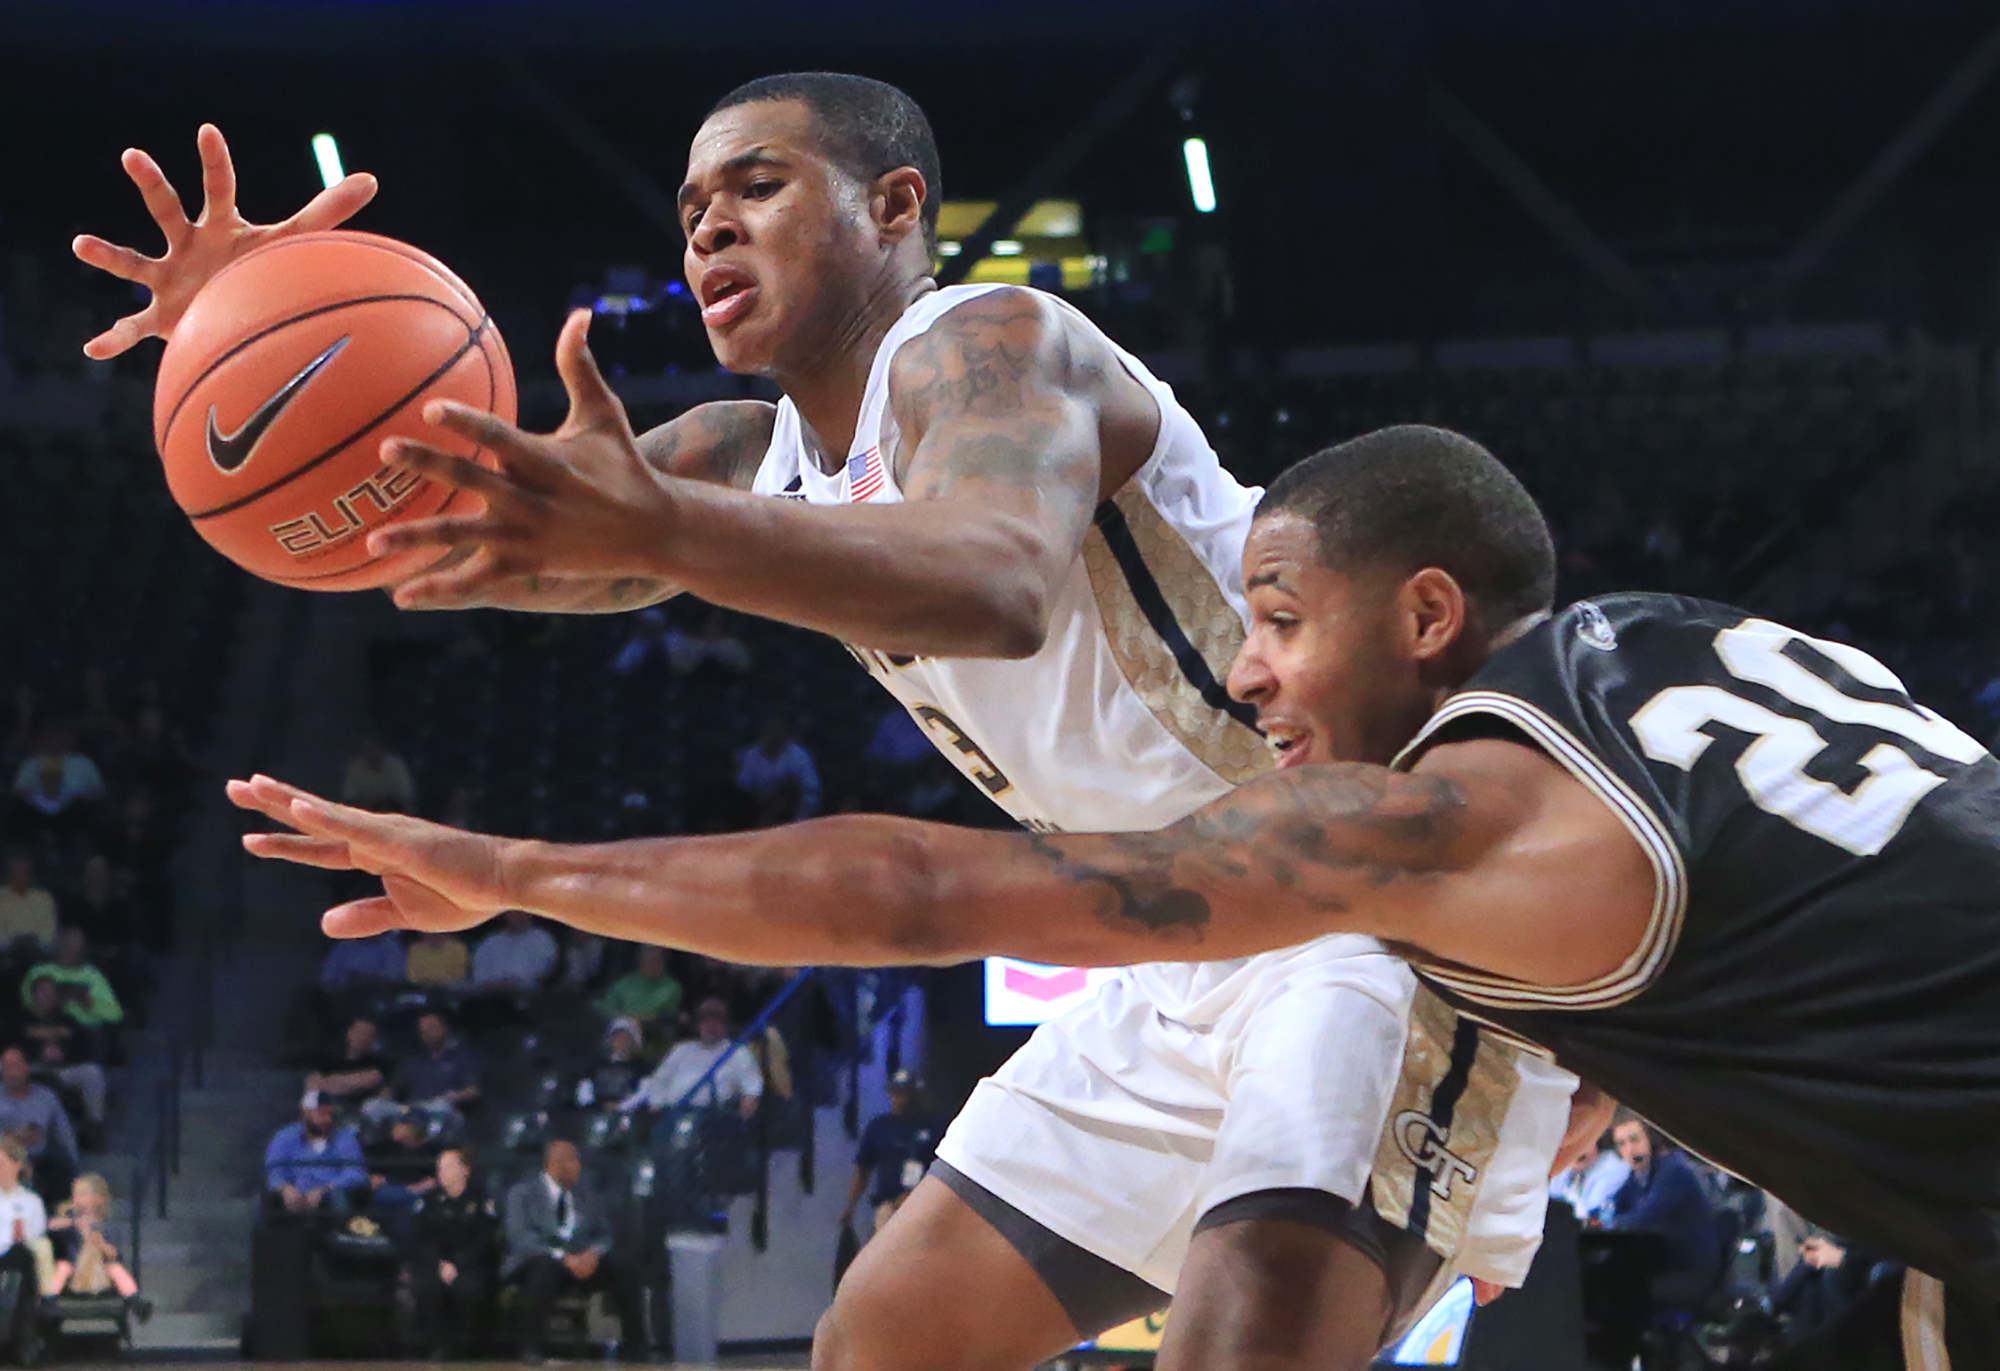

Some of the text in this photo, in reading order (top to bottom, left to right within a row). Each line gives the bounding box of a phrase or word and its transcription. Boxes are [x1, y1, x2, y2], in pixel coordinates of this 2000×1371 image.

[269, 464, 423, 555] ELITE
[912, 702, 1015, 798] 3
[1628, 618, 1989, 856] 20
[1393, 1109, 1478, 1201] GT
